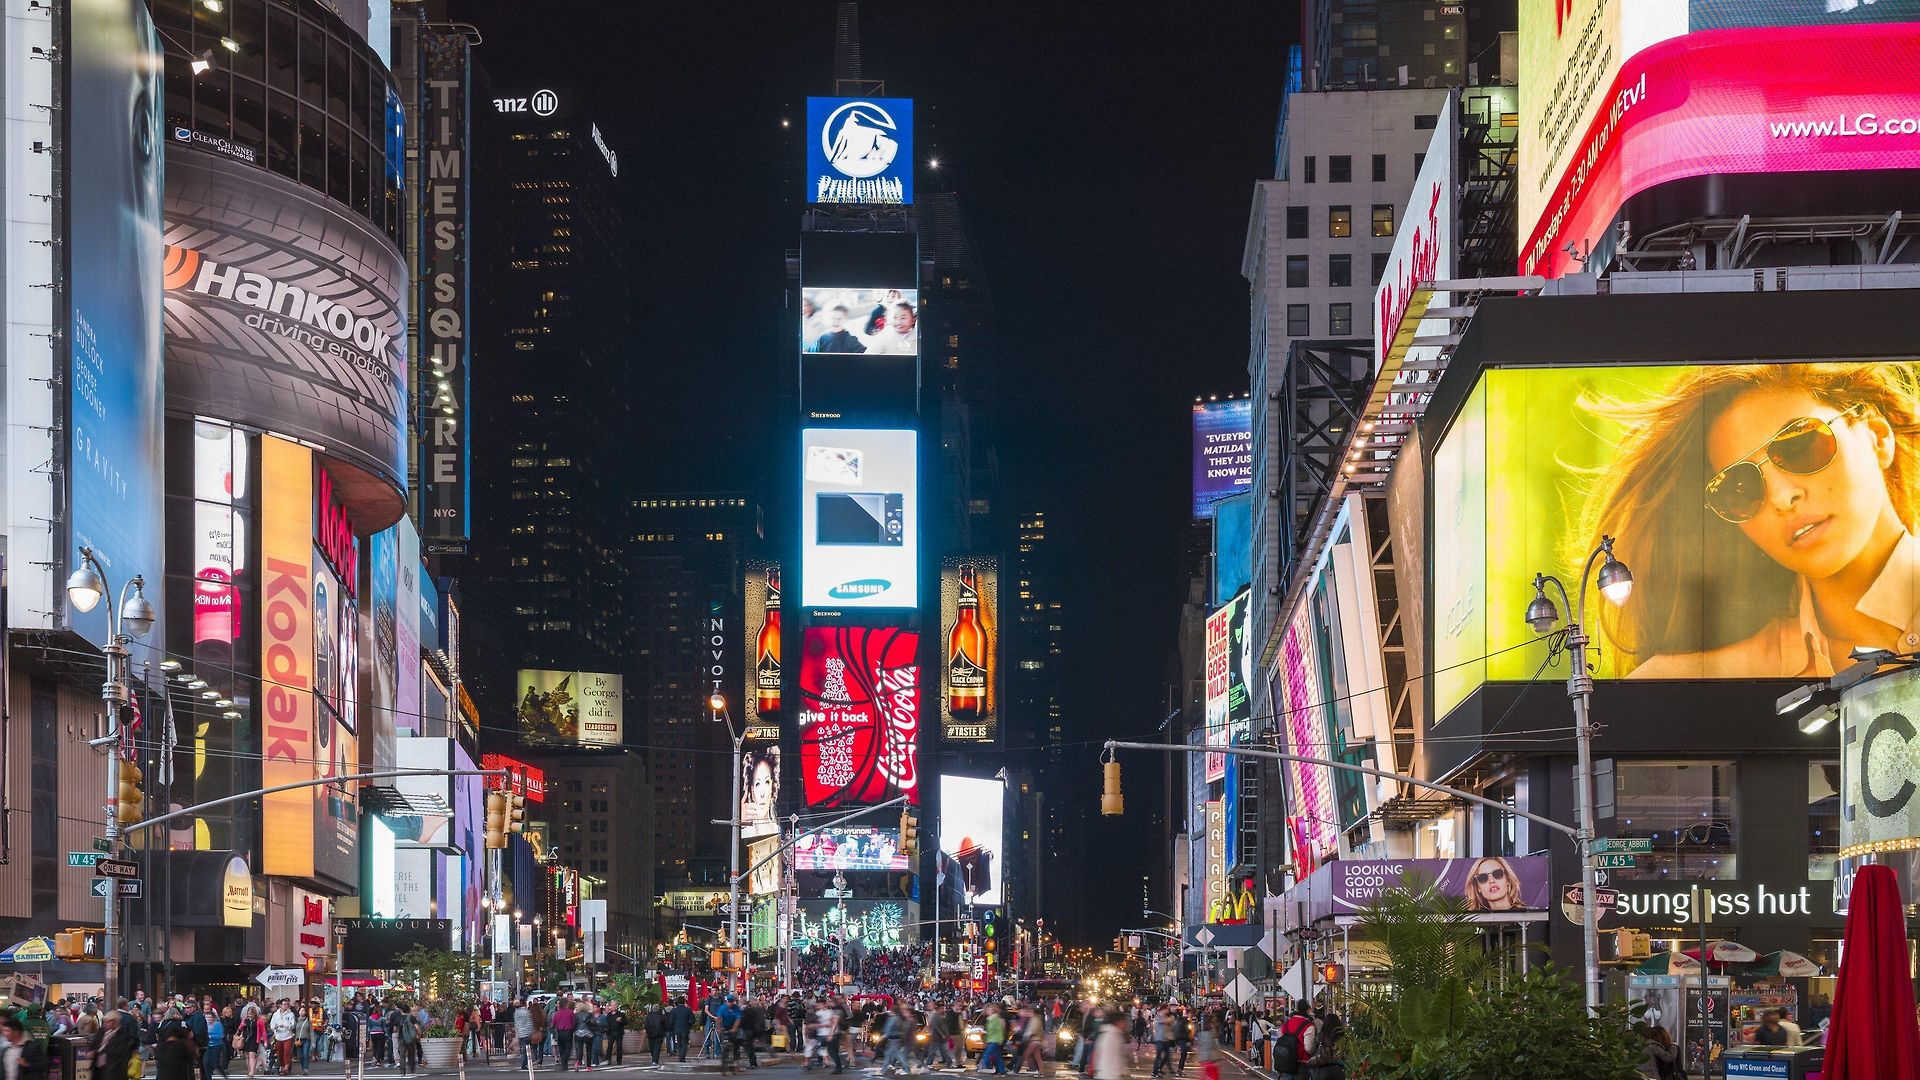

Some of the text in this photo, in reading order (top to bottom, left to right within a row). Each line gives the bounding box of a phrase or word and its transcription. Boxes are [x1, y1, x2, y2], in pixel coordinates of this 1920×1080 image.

[1544, 101, 1554, 132] the
[1553, 76, 1567, 110] Mixx
[1567, 8, 1597, 79] Premieres
[1545, 29, 1603, 152] Thursdays @ 7:30am
[1538, 45, 1612, 193] www.inthemixxshow.com
[1770, 112, 1920, 139] www.LG.co
[217, 146, 254, 162] SPECTACOLOR
[817, 175, 903, 200] Prudential
[1535, 202, 1564, 264] Thursdays
[1563, 188, 1571, 212] at
[1571, 166, 1587, 203] 7:30
[1586, 140, 1598, 178] AM
[1600, 124, 1609, 152] on
[430, 80, 461, 483] TIMES SQUARE
[76, 308, 97, 346] SANDRA
[76, 325, 104, 375] BULLOCK
[245, 312, 390, 385] driving emotion
[76, 355, 97, 392] GEORGE
[76, 374, 107, 422] CLOONEY
[1203, 444, 1243, 455] MATILDA
[76, 426, 127, 501] GRAVITY
[1209, 457, 1234, 468] THEY
[1207, 468, 1237, 478] KNOW
[433, 508, 456, 518] NYC
[319, 467, 357, 603] Kodak
[1207, 611, 1227, 645] THE
[1207, 636, 1227, 662] CROWD
[266, 557, 310, 765] Kodak
[1207, 653, 1227, 682] GOES
[711, 619, 723, 722] NOVOTL
[595, 677, 607, 689] By
[1207, 672, 1228, 702] WILD!
[583, 687, 619, 699] George,
[588, 707, 613, 717] did it.
[799, 710, 869, 725] give it back
[947, 728, 987, 737] #TASTE IS
[843, 827, 872, 835] HYUNDAI
[1607, 840, 1649, 848] GEORGE ABBOTT
[69, 854, 95, 865] W 45
[1211, 812, 1220, 908] PALACE
[1598, 855, 1609, 867] W
[1612, 855, 1626, 867] 45
[103, 863, 133, 874] ONE WAY
[1345, 865, 1403, 876] LOOKING
[403, 882, 419, 892] THE
[1345, 877, 1384, 887] GOOD
[1439, 878, 1451, 892] play
[227, 885, 249, 897] Marriott
[1345, 888, 1375, 898] NEW
[1616, 884, 1811, 923] sungss hut
[351, 920, 445, 929] MARQUIS
[974, 958, 984, 980] tkts
[267, 973, 287, 983] PRIVATE
[1696, 977, 1718, 985] TAN
[1728, 1063, 1739, 1071] Keep
[1739, 1063, 1748, 1071] NYC
